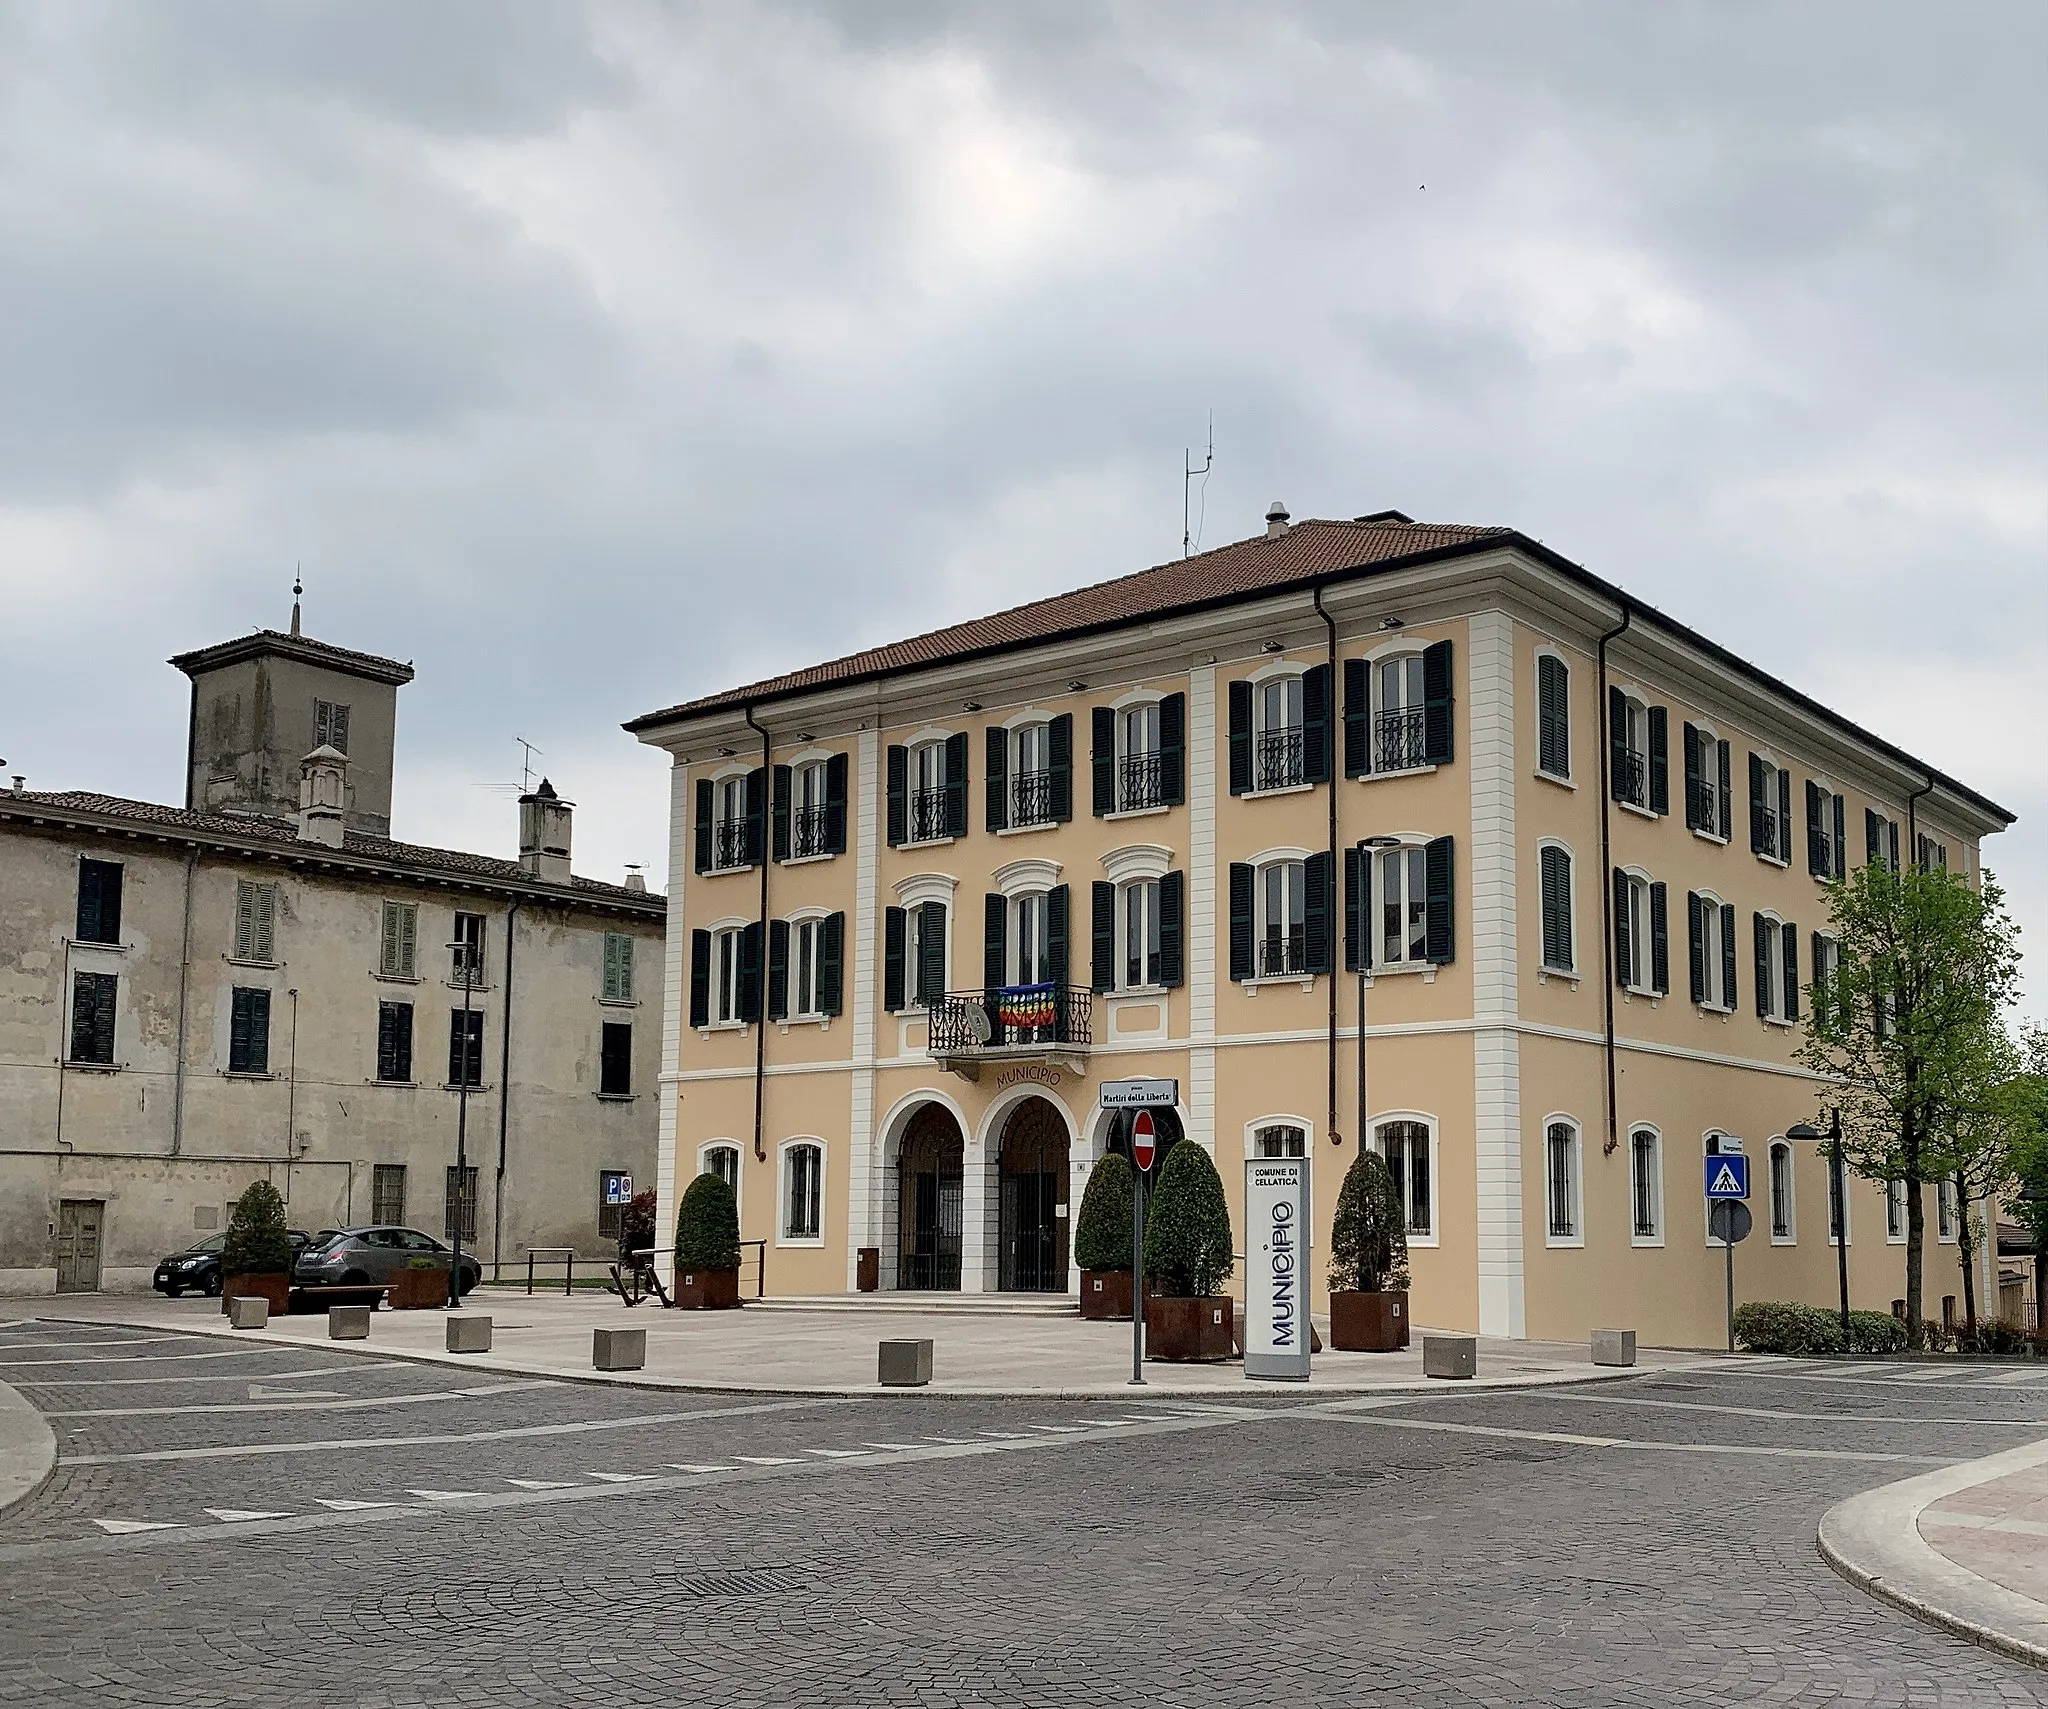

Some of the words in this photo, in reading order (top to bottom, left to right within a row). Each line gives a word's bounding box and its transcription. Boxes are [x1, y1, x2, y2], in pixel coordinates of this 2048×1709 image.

[997, 1066, 1060, 1088] MUNICIPIO
[1103, 1094, 1126, 1102] Martiri
[1128, 1093, 1145, 1102] della
[1255, 1168, 1287, 1177] COMUNE
[1289, 1168, 1298, 1176] DI
[609, 1178, 617, 1194] P
[1255, 1178, 1298, 1186] CELLATICA
[1272, 1201, 1294, 1346] MUNICIPIO
